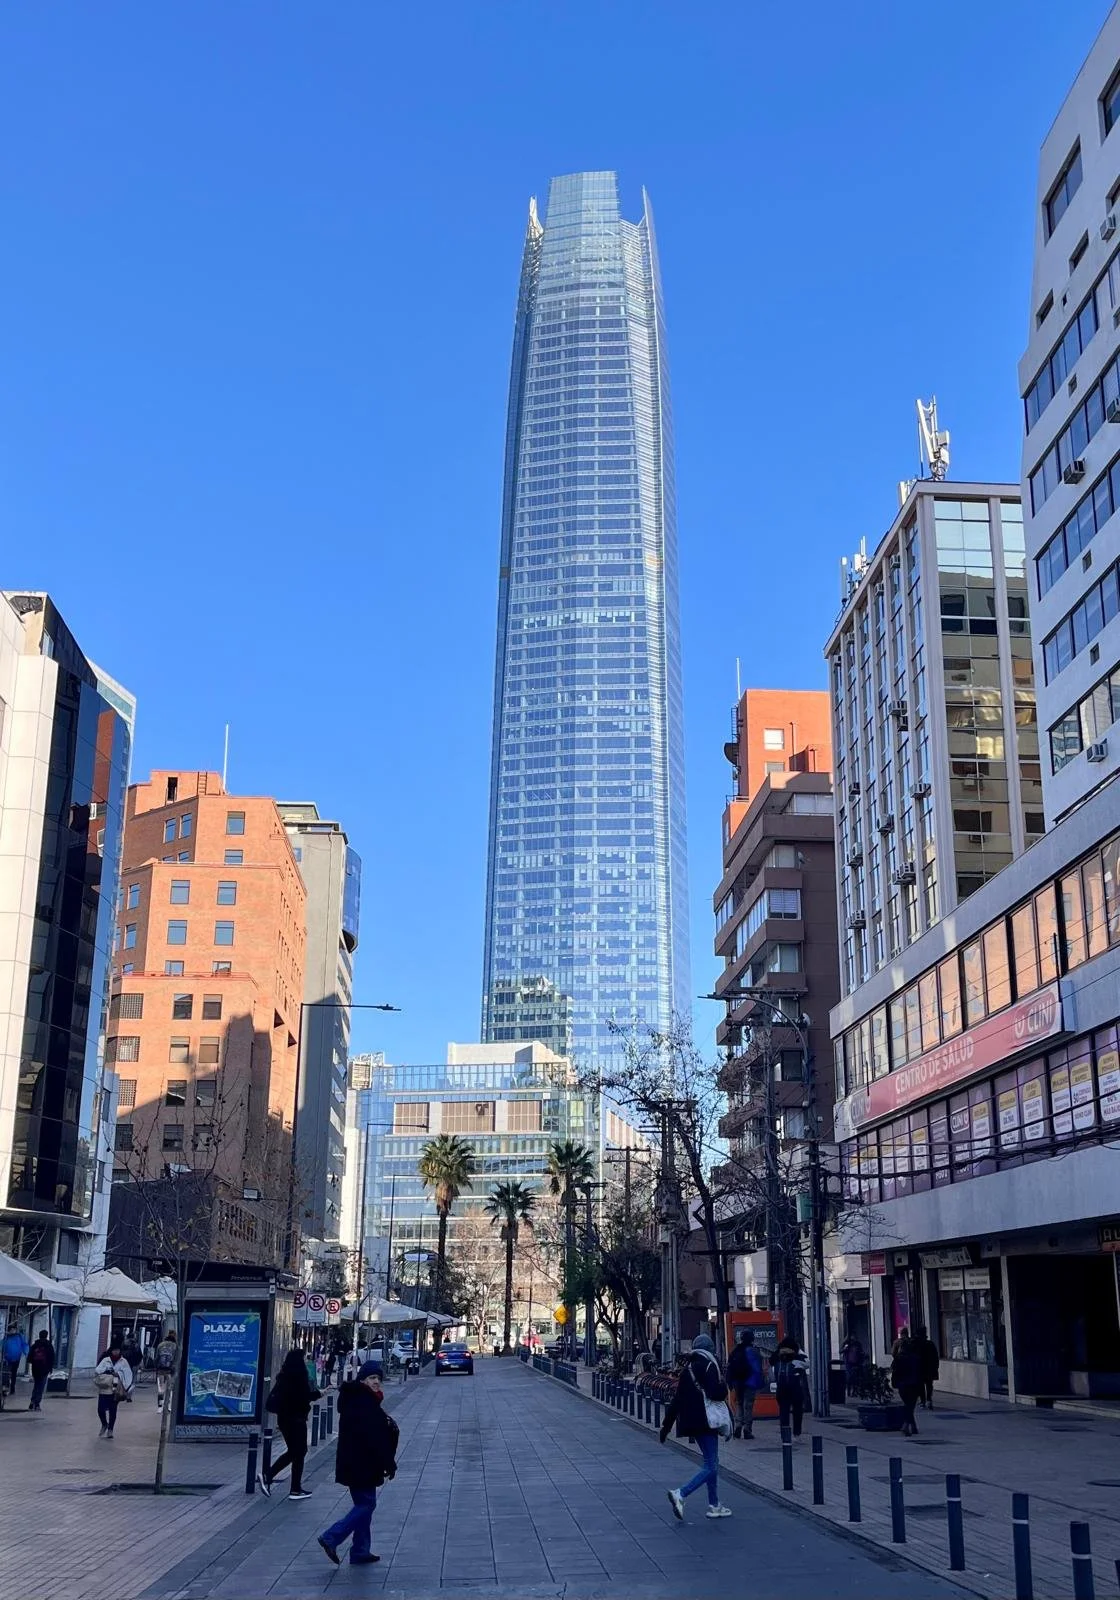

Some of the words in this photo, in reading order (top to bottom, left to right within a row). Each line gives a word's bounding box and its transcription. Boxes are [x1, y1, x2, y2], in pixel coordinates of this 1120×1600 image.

[895, 1063, 927, 1095] CENTRO
[929, 1053, 941, 1079] DE
[943, 1036, 974, 1071] SALUD
[203, 1324, 247, 1333] PLAZAS
